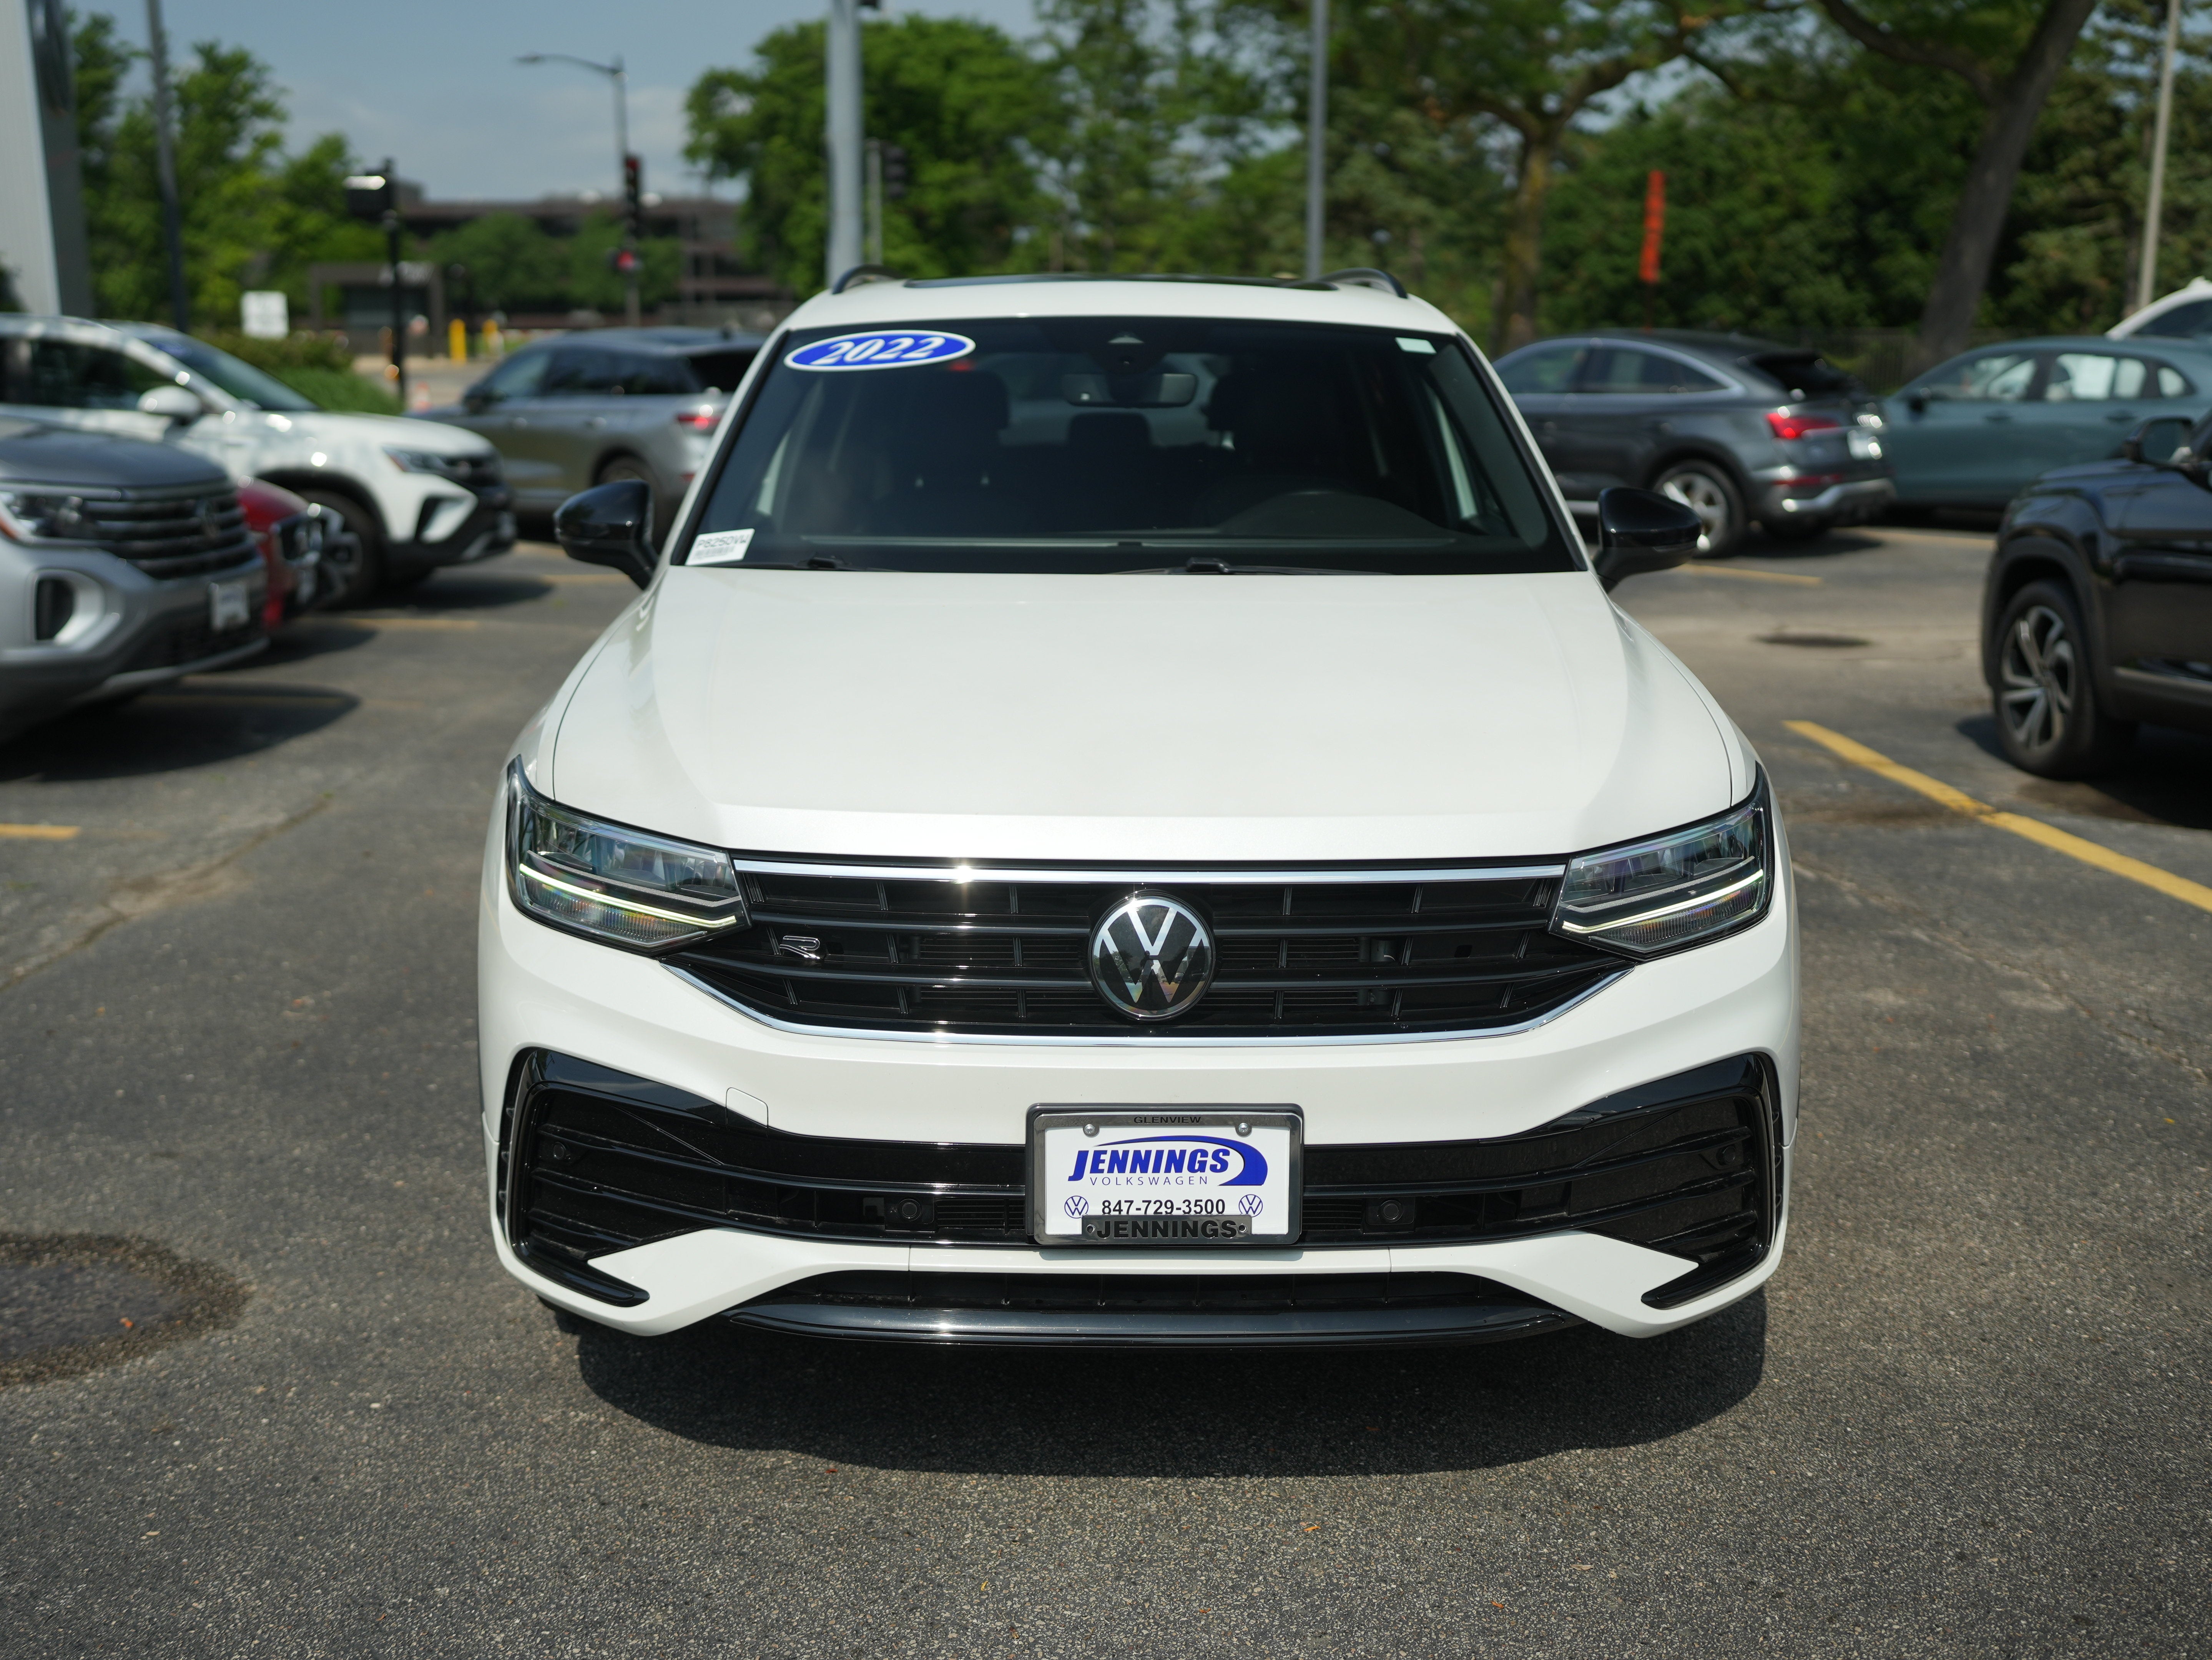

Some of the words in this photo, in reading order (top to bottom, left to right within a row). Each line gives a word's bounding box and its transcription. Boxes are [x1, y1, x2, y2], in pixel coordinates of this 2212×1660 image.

[809, 337, 946, 365] 2022
[1068, 1149, 1230, 1182] JENNINGS
[1090, 1176, 1207, 1185] VOLKSWAGEN
[1102, 1199, 1225, 1215] 847-729-3500
[1097, 1220, 1237, 1239] JENNINGS
